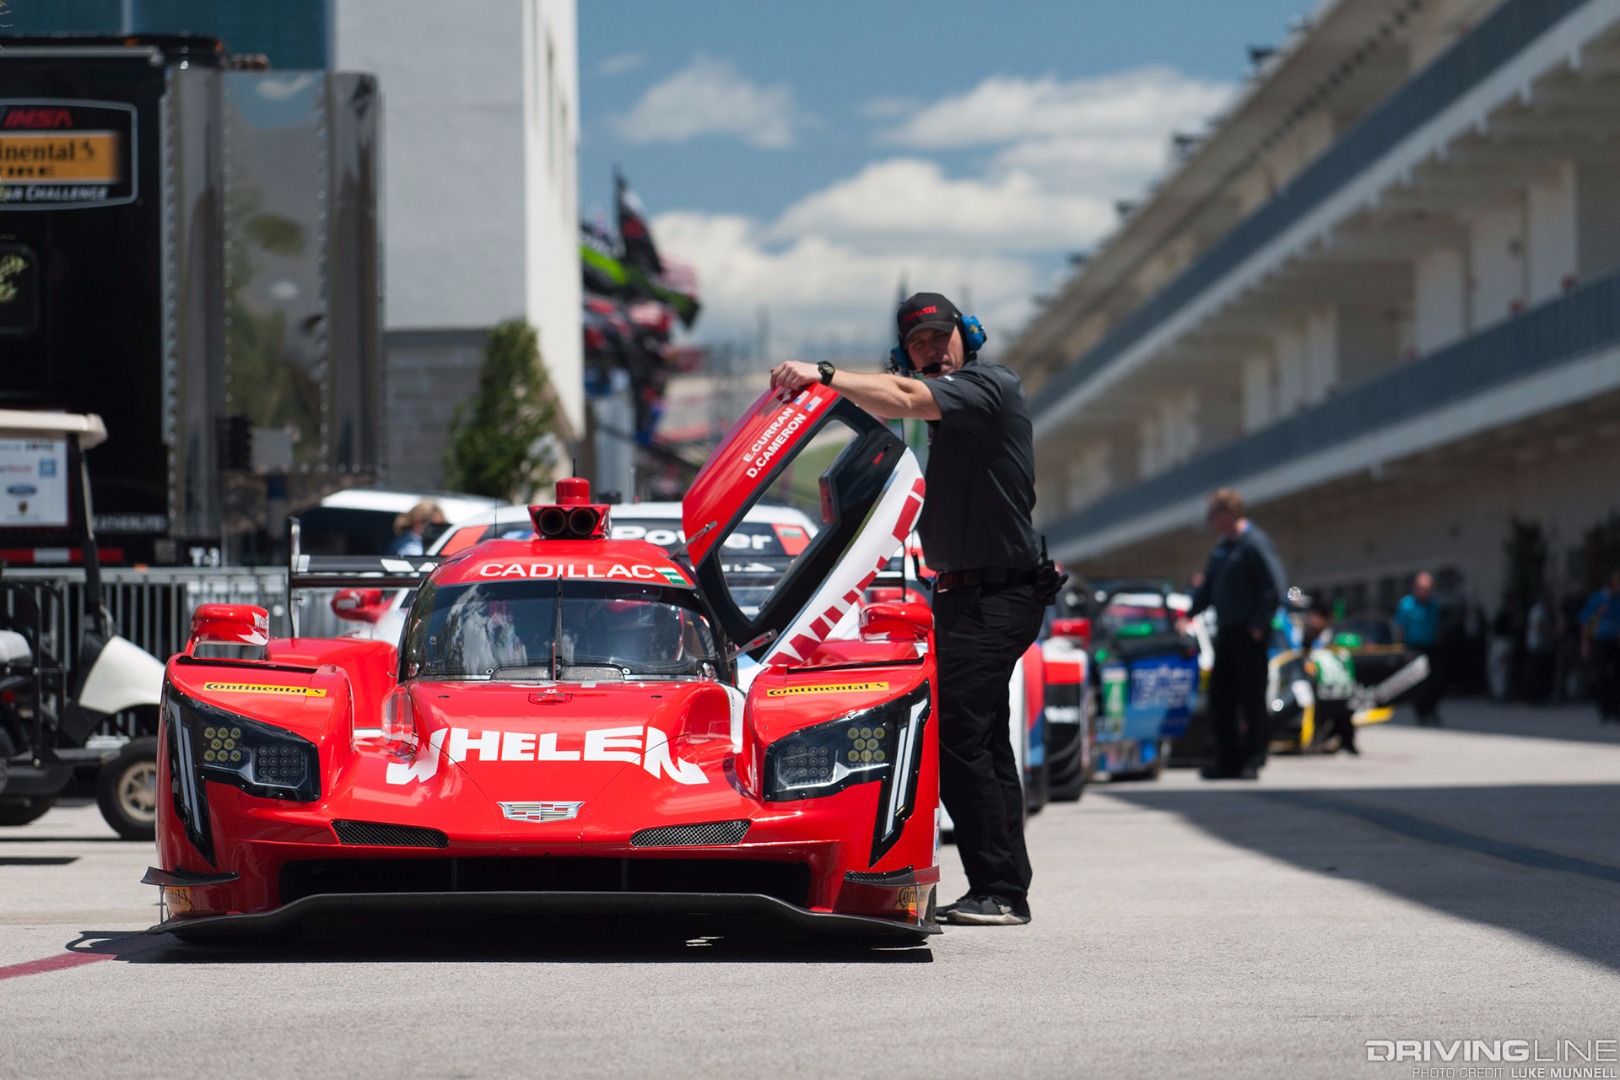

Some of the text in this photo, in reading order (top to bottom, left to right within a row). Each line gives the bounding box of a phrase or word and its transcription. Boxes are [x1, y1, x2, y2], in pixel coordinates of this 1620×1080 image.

[0, 166, 54, 178] IRE
[743, 407, 795, 463] E.CURRAN
[746, 413, 807, 479] D.CAMERON
[611, 526, 772, 550] Poer
[479, 563, 656, 578] CADILLAC
[205, 683, 308, 695] Continental
[768, 684, 869, 696] Continental
[386, 725, 710, 785] WHELEN
